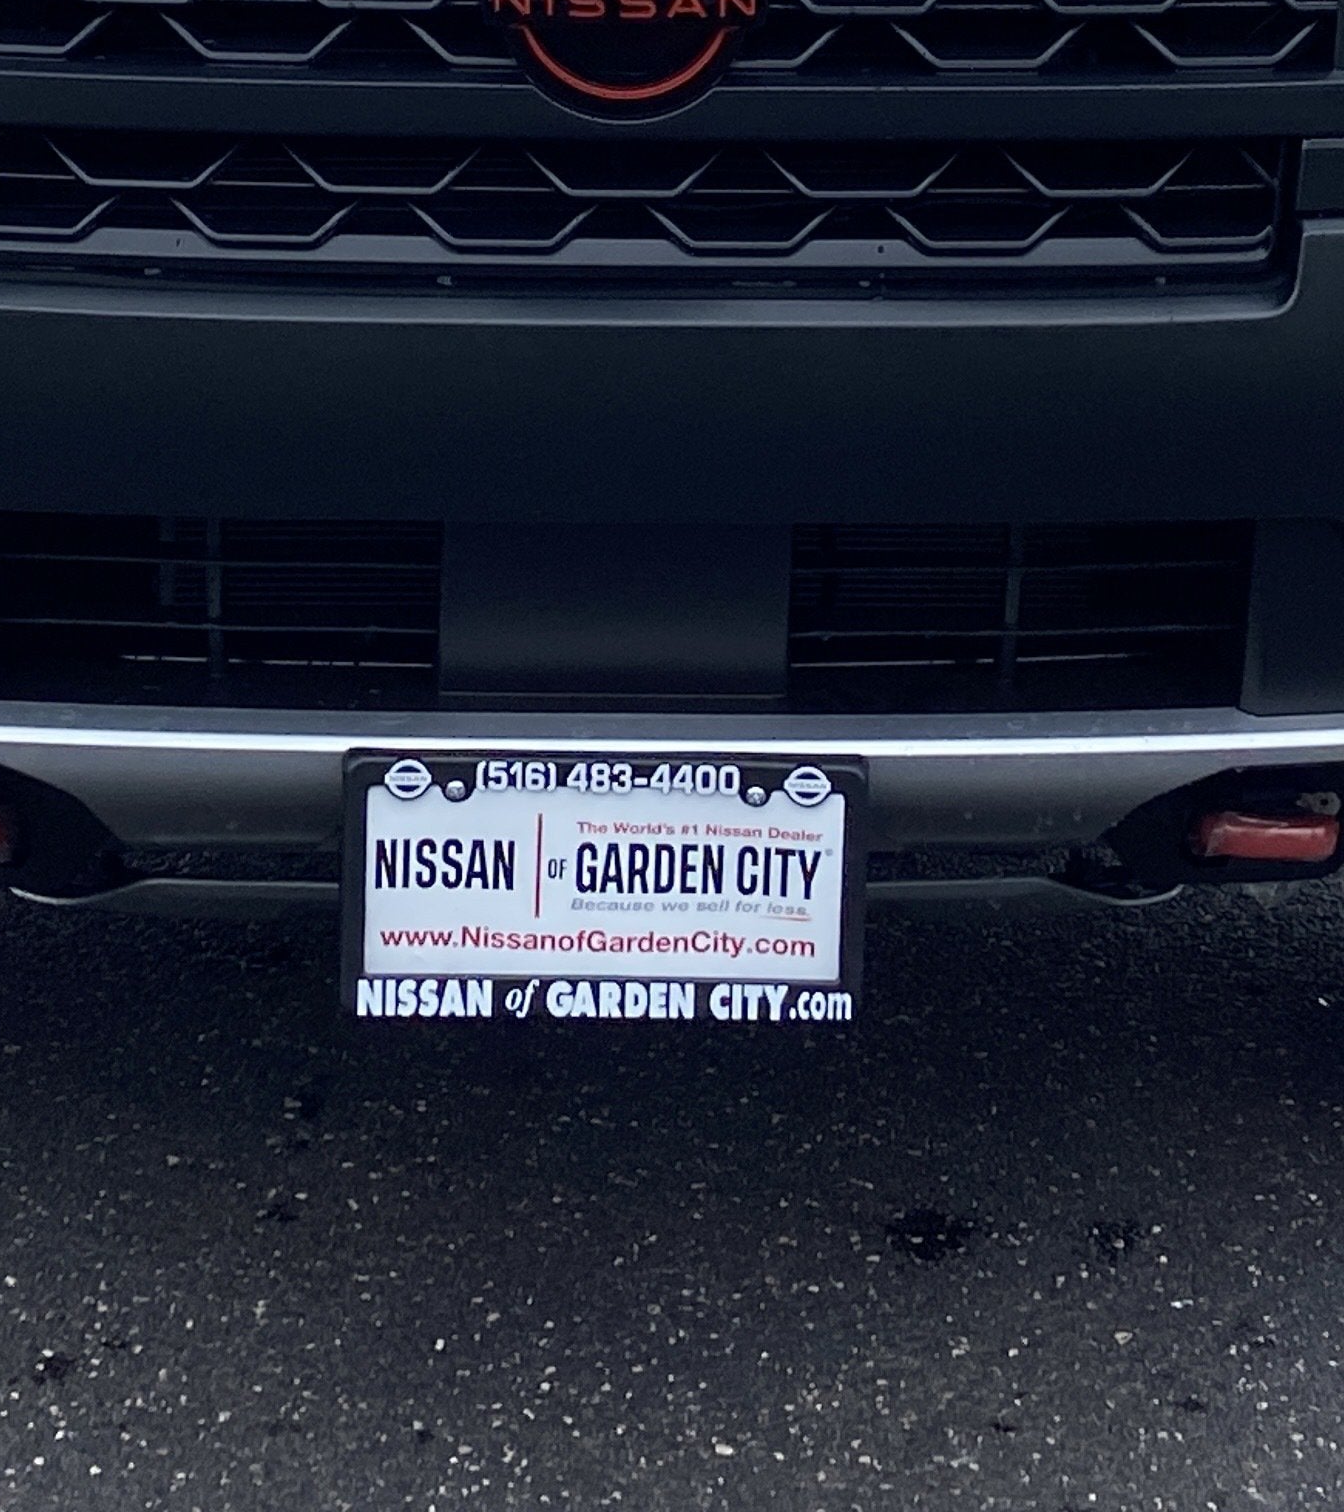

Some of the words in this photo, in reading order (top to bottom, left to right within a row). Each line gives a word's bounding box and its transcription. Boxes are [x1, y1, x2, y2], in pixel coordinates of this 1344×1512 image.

[475, 760, 557, 791] (516)
[566, 761, 741, 794] 483-4400
[577, 821, 607, 835] The
[613, 822, 675, 836] World's
[681, 824, 698, 836] #1
[706, 825, 762, 839] Nissan
[768, 828, 823, 842] Dealer
[374, 838, 516, 890] NISSAN
[547, 858, 567, 880] OF
[575, 841, 724, 894] GARDEN
[737, 845, 822, 900] CITY
[571, 898, 654, 912] Because
[662, 901, 688, 912] we
[696, 900, 730, 913] sell
[735, 901, 761, 914] for
[380, 926, 816, 958] www.NissanofGardenCity.com
[356, 978, 492, 1018] NISSAN
[505, 975, 540, 1018] of
[545, 981, 697, 1020] GARDEN
[709, 983, 853, 1021] CITY.com
